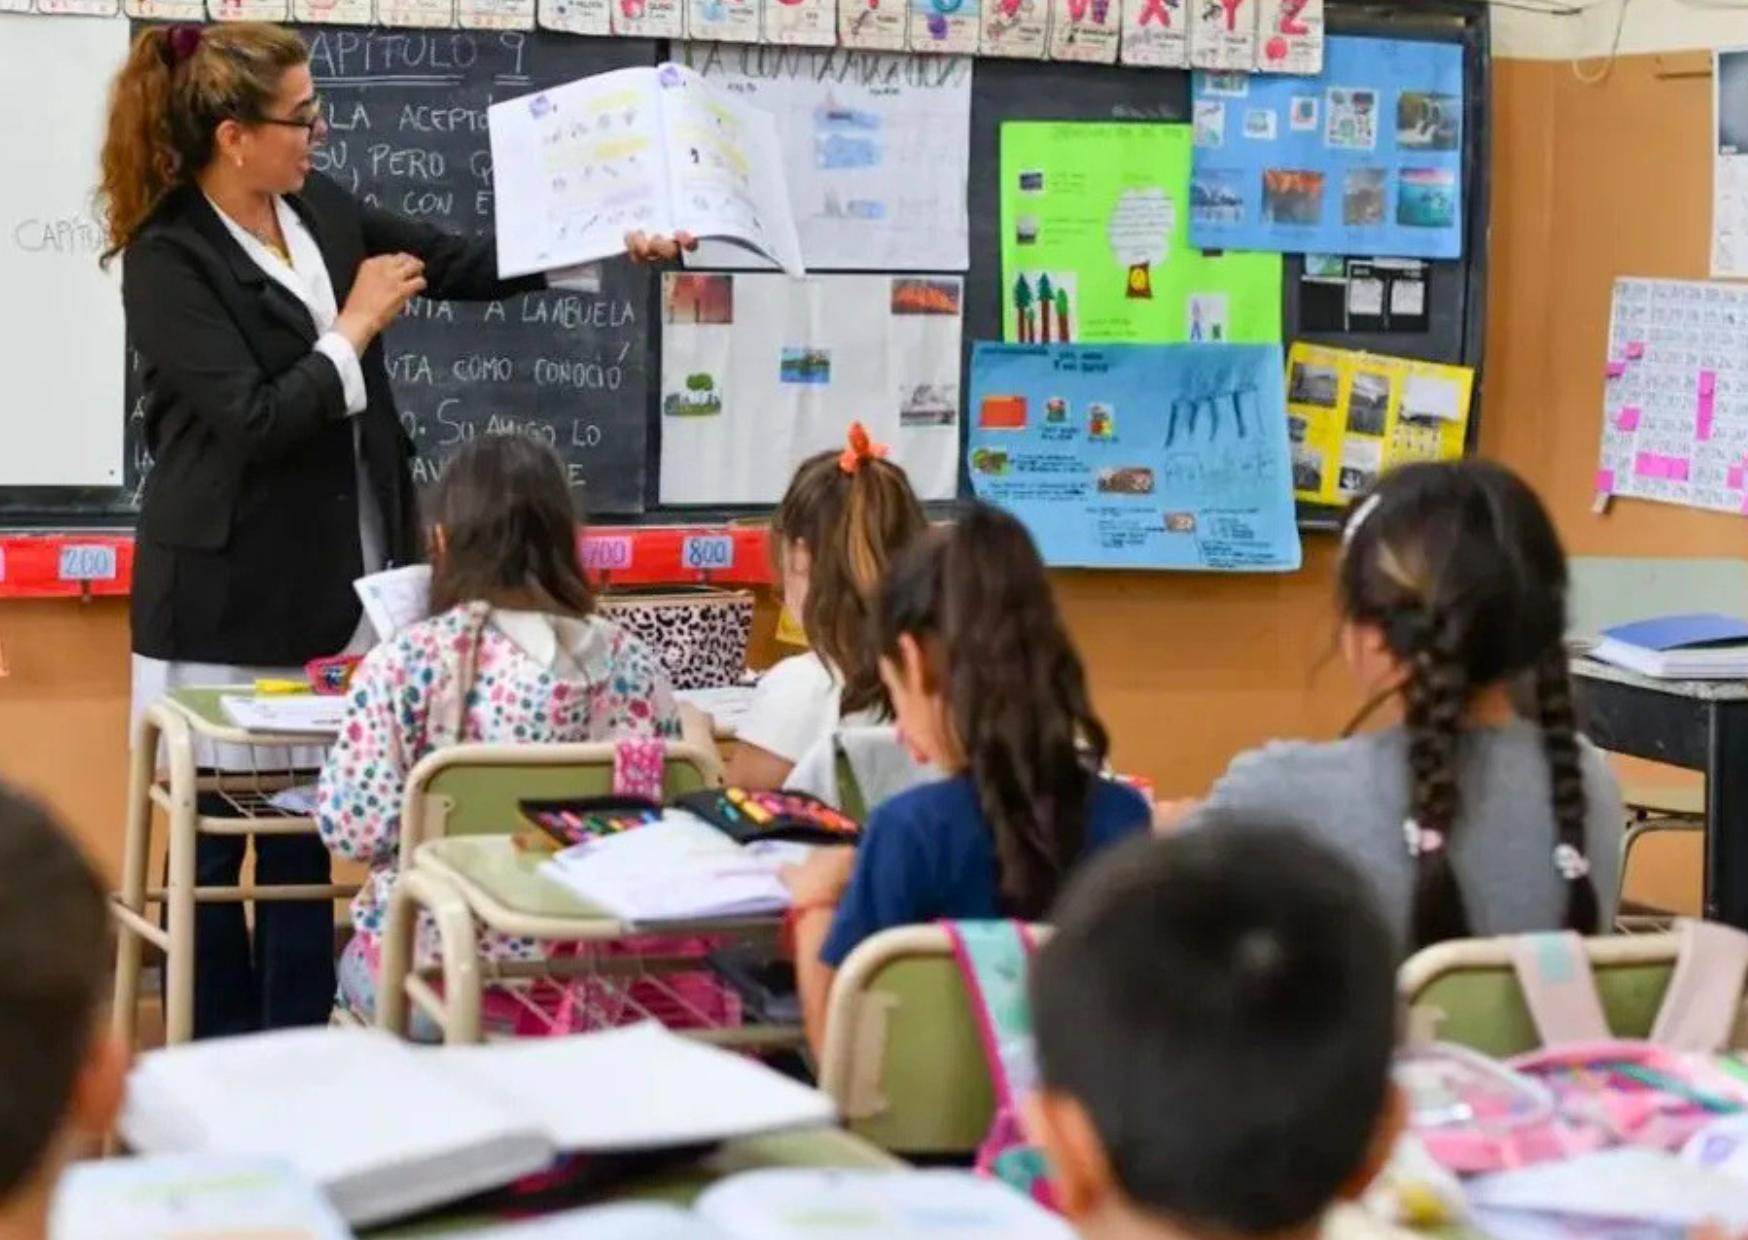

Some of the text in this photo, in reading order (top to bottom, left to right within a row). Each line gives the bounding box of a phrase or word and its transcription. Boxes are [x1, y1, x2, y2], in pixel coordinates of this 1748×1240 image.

[308, 28, 525, 77] APÍTULO 9
[367, 142, 446, 181] PERO
[402, 191, 454, 215] CON
[484, 299, 506, 322] A
[571, 418, 602, 447] LO
[63, 549, 110, 577] 200
[688, 537, 728, 567] 800
